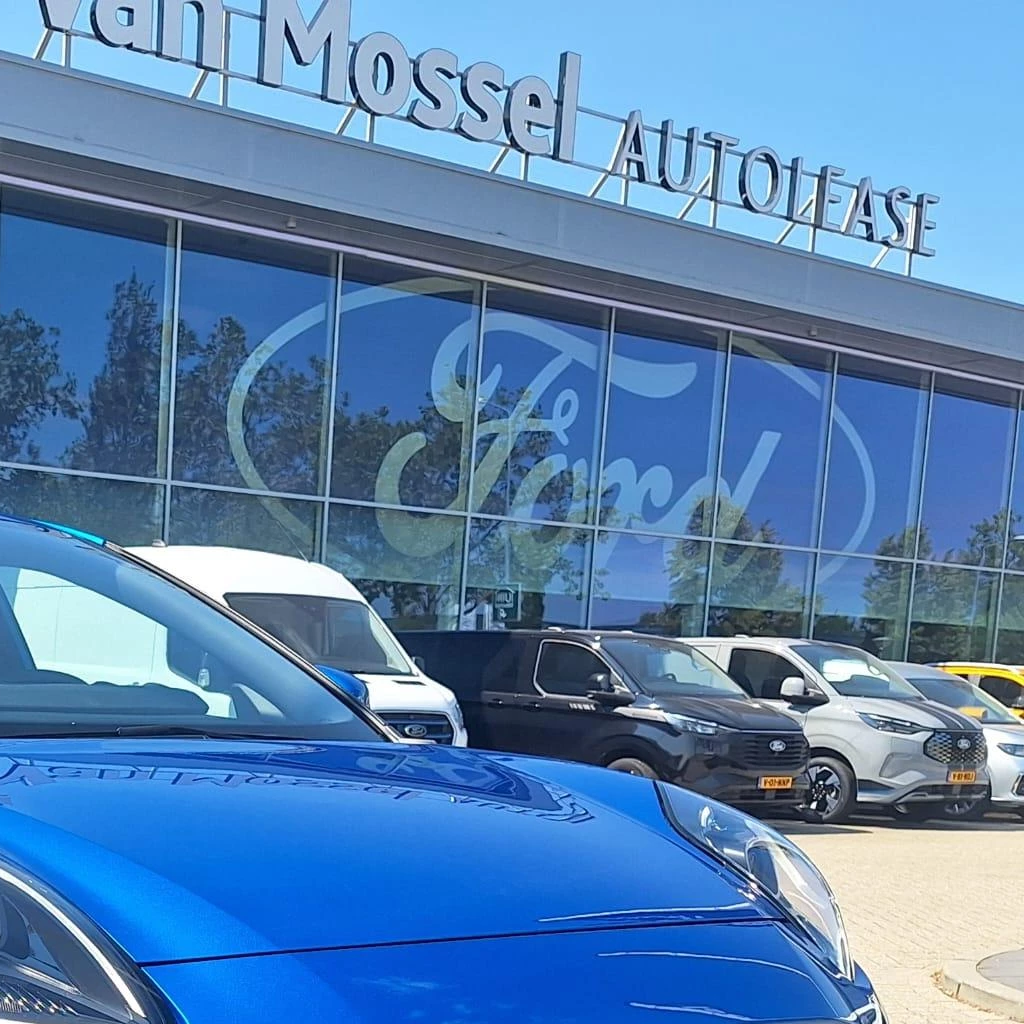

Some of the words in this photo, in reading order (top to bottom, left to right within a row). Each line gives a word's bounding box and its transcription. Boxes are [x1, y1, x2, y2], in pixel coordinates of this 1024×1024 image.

[256, 0, 582, 163] Mossel
[609, 109, 941, 257] AUTOLEASE
[375, 311, 783, 587] Ford
